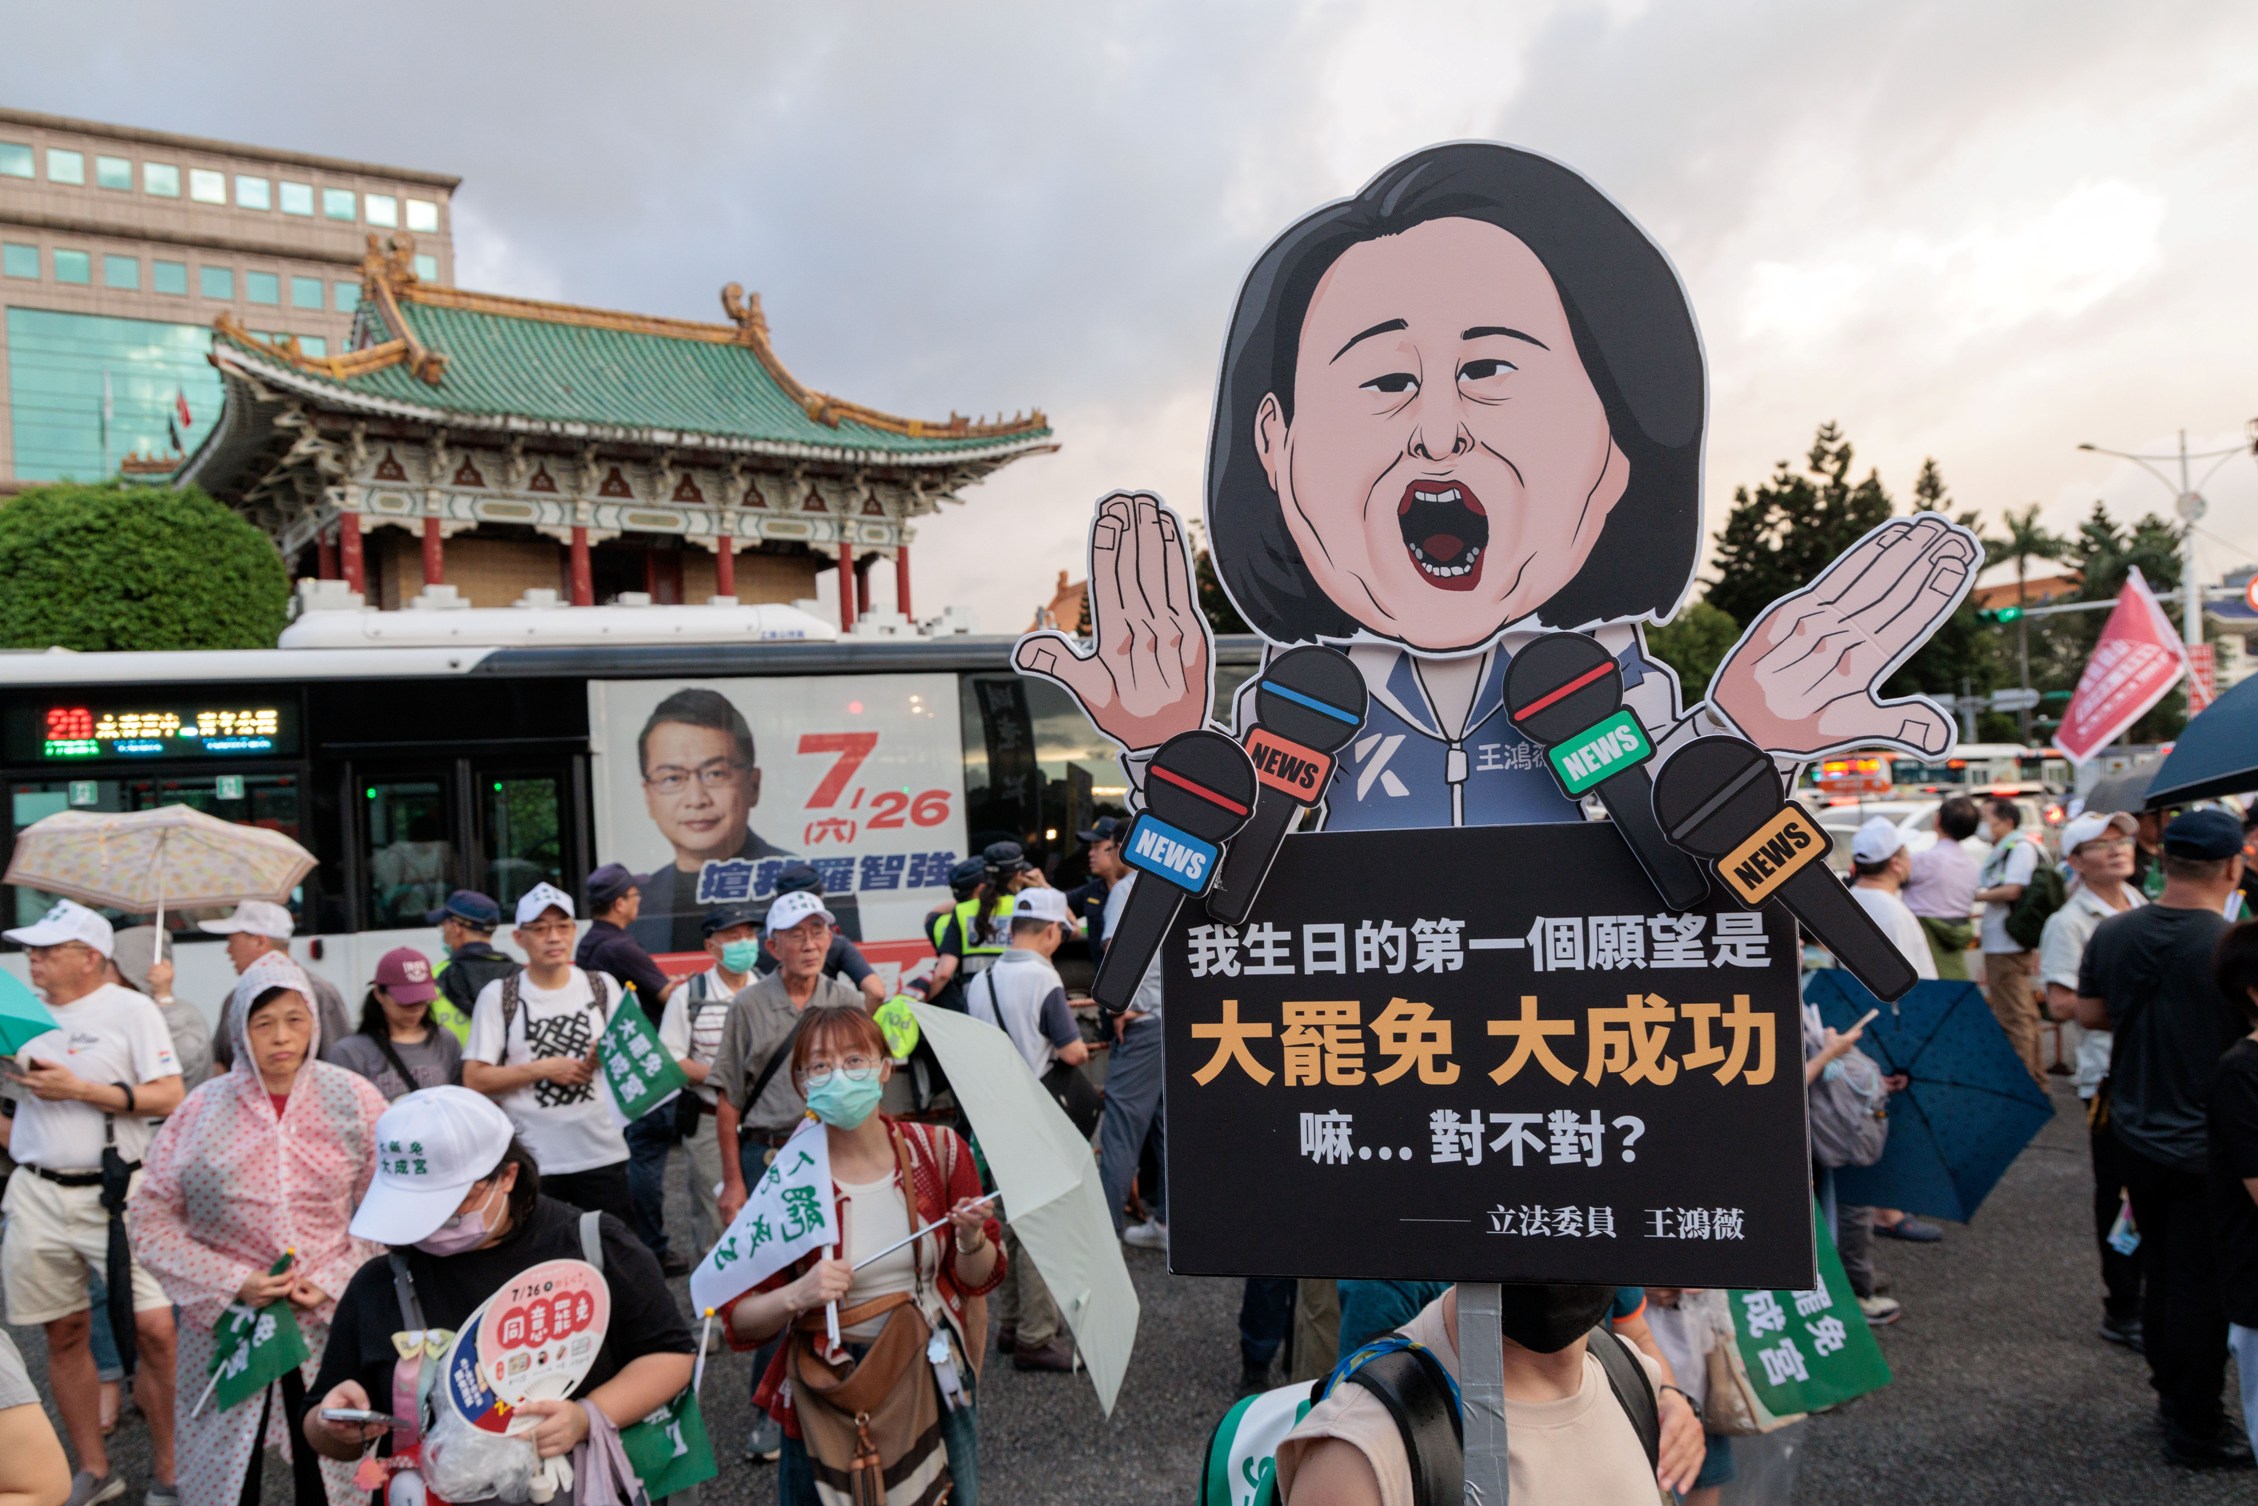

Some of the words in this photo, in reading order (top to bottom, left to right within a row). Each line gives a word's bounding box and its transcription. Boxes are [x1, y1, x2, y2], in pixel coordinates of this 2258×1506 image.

[797, 731, 952, 829] 7/26
[1251, 742, 1319, 789] NEWS
[1562, 724, 1640, 782] NEWS
[804, 817, 857, 846] (六)
[1134, 828, 1207, 880] NEWS
[1733, 821, 1811, 891] NEWS
[1188, 912, 1771, 977] 我生日的第一個願望是
[1191, 996, 1461, 1087] 大罷免
[1486, 993, 1776, 1088] 大成功
[1486, 1204, 1617, 1239] 立法委員
[1644, 1206, 1745, 1241] 王鴻薇
[502, 1297, 590, 1344] 同意罷免
